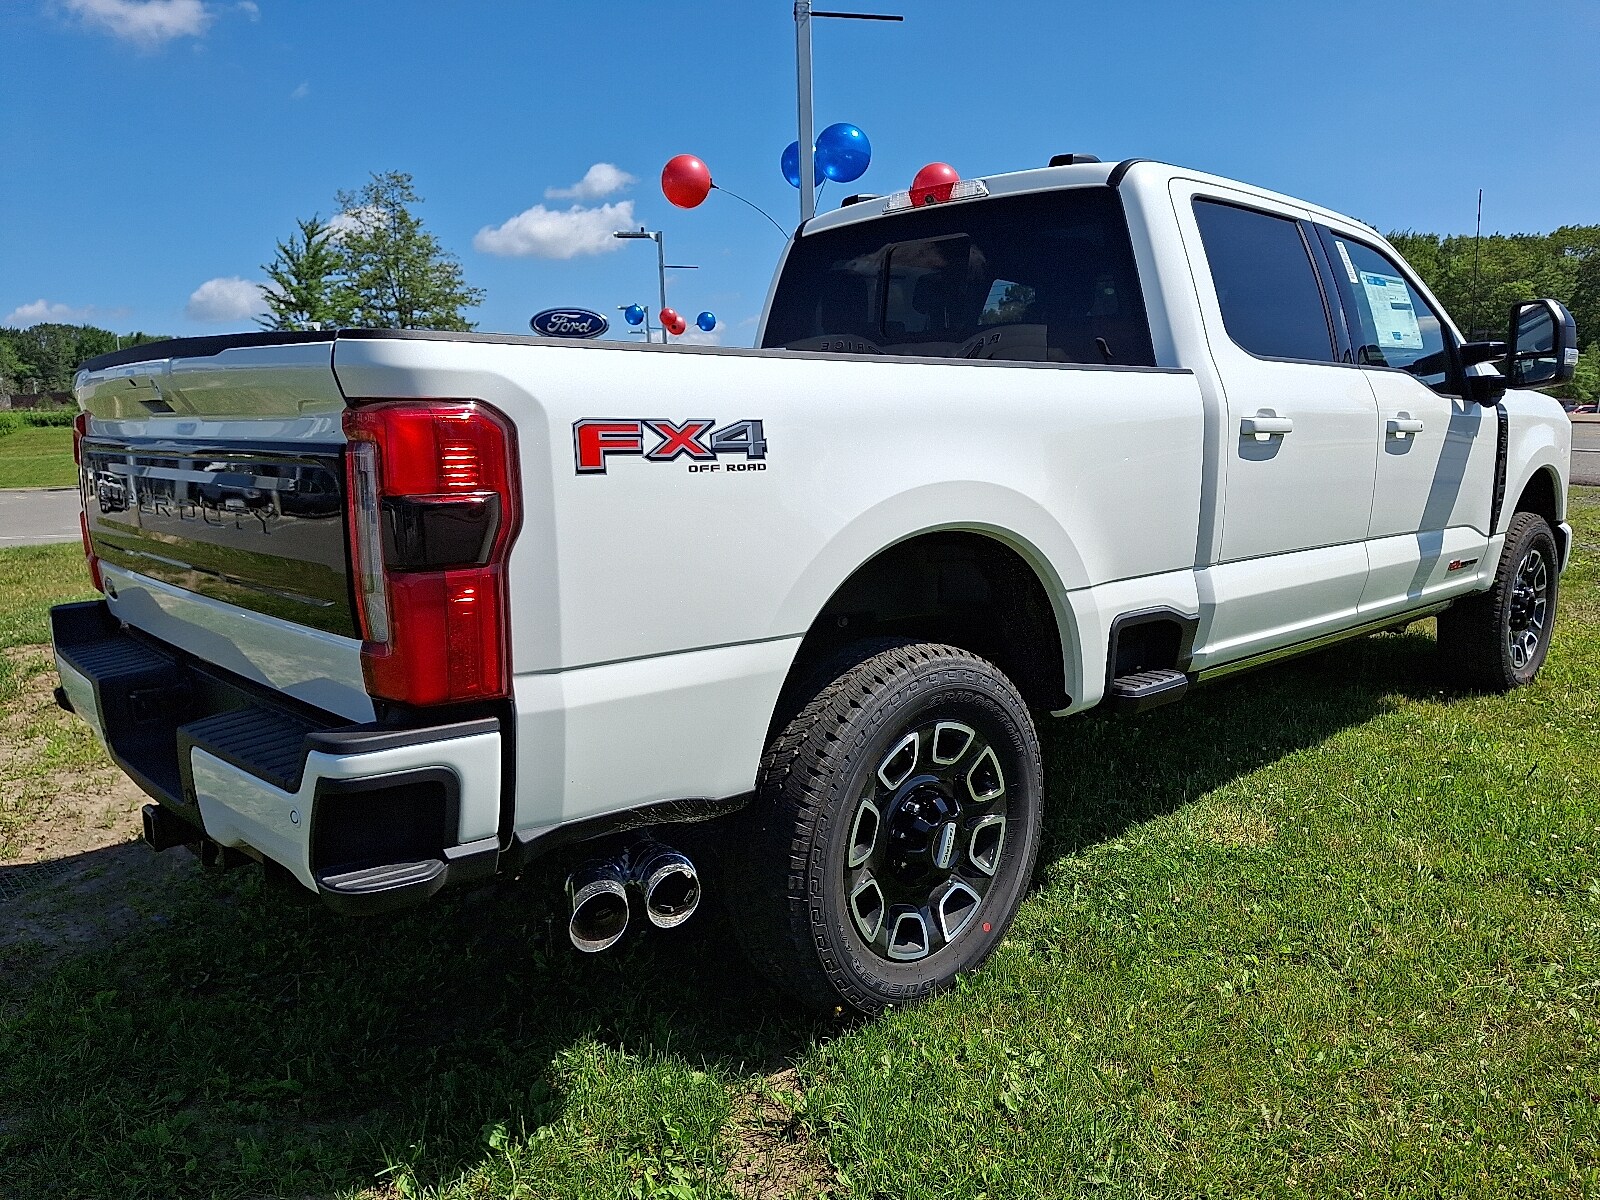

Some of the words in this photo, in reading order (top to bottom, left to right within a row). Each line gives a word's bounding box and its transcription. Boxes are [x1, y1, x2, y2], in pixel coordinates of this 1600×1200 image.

[547, 313, 592, 332] Ford
[571, 417, 768, 475] FX4
[688, 464, 721, 473] OFF
[726, 463, 767, 472] ROAD
